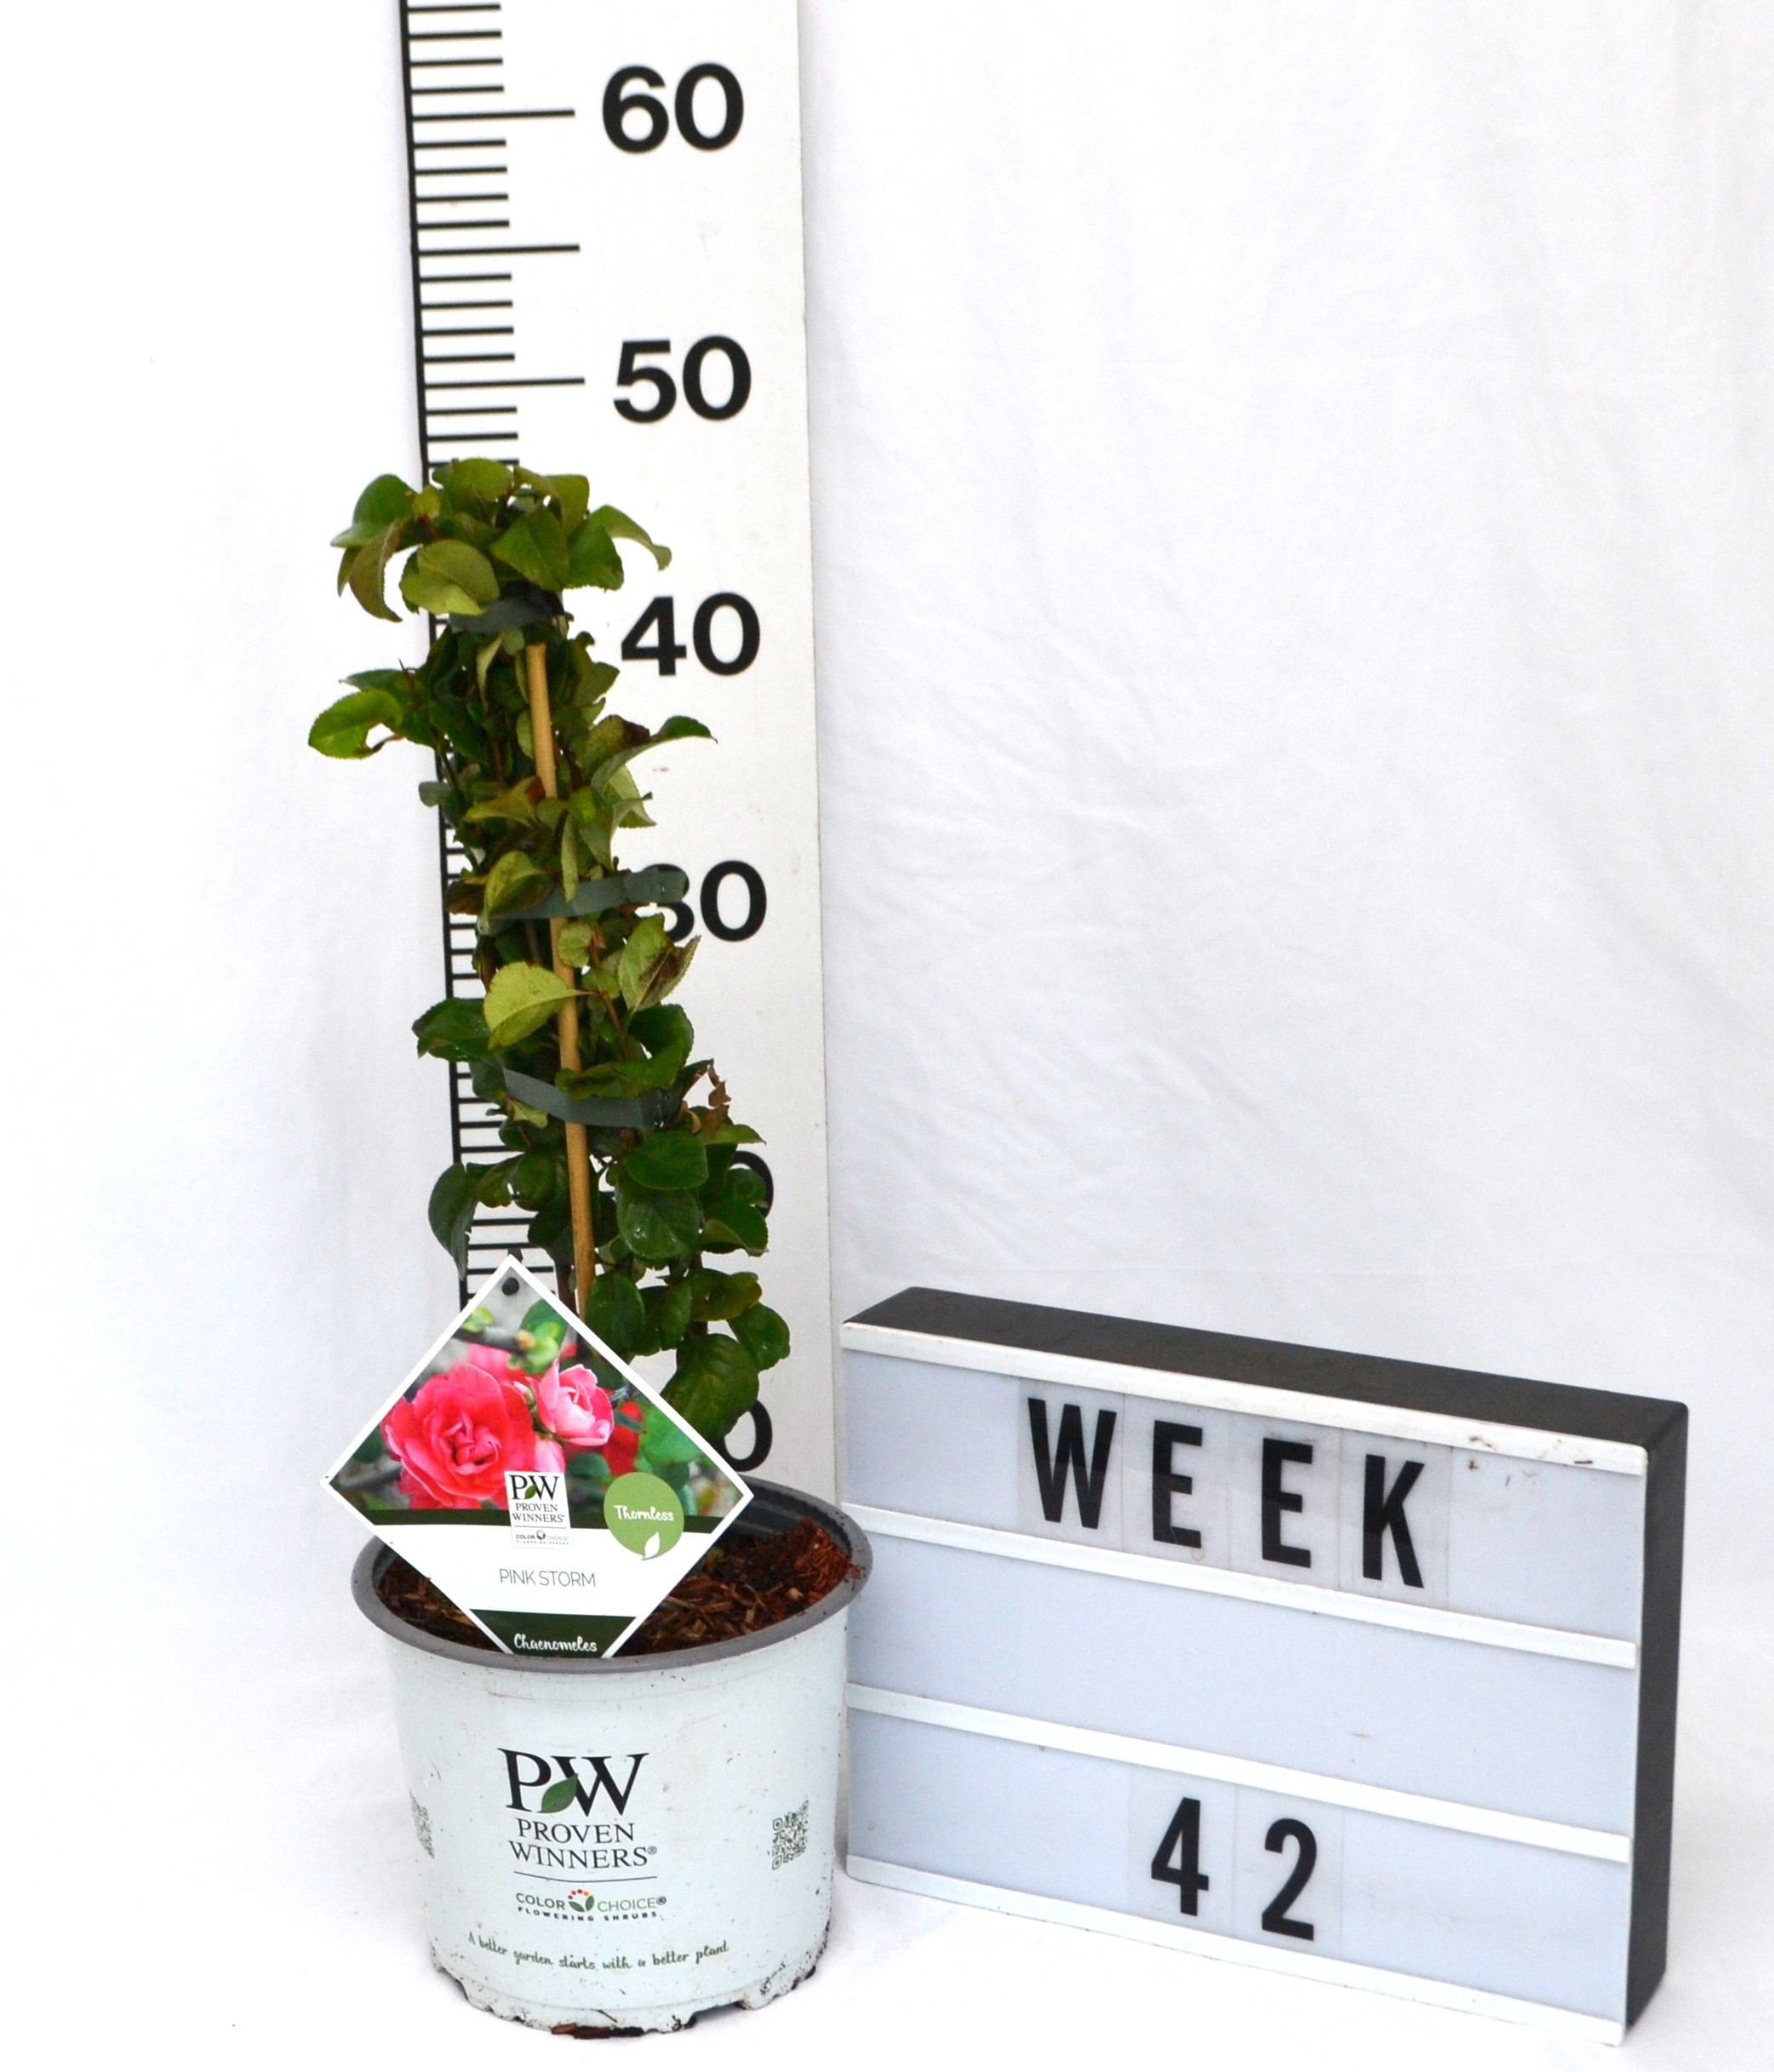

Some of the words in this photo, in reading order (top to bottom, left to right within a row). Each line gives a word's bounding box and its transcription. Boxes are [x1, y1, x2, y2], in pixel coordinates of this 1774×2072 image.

[602, 62, 745, 154] 60
[613, 335, 752, 424] 50
[621, 592, 761, 677] 40
[508, 1474, 559, 1501] PW
[1027, 1398, 1426, 1589] WEEK
[515, 1502, 558, 1513] PROVEN
[613, 1504, 674, 1522] Thornless
[499, 1569, 536, 1586] PINK
[539, 1571, 597, 1588] STORM
[513, 1633, 598, 1652] Chaenomeles
[497, 1748, 650, 1817] PW
[517, 1817, 635, 1845] PROVEN
[1150, 1797, 1319, 1943] 42
[516, 1892, 566, 1910] COLOR
[518, 1906, 594, 1922] FLOWERING
[604, 1911, 658, 1922] SHRUBS
[468, 1932, 475, 1945] A
[478, 1936, 508, 1955] better
[513, 1949, 554, 1966] garden
[558, 1955, 596, 1969] starts
[602, 1955, 632, 1969] with
[638, 1959, 647, 1967] a
[652, 1953, 689, 1966] better
[695, 1940, 730, 1964] plant
